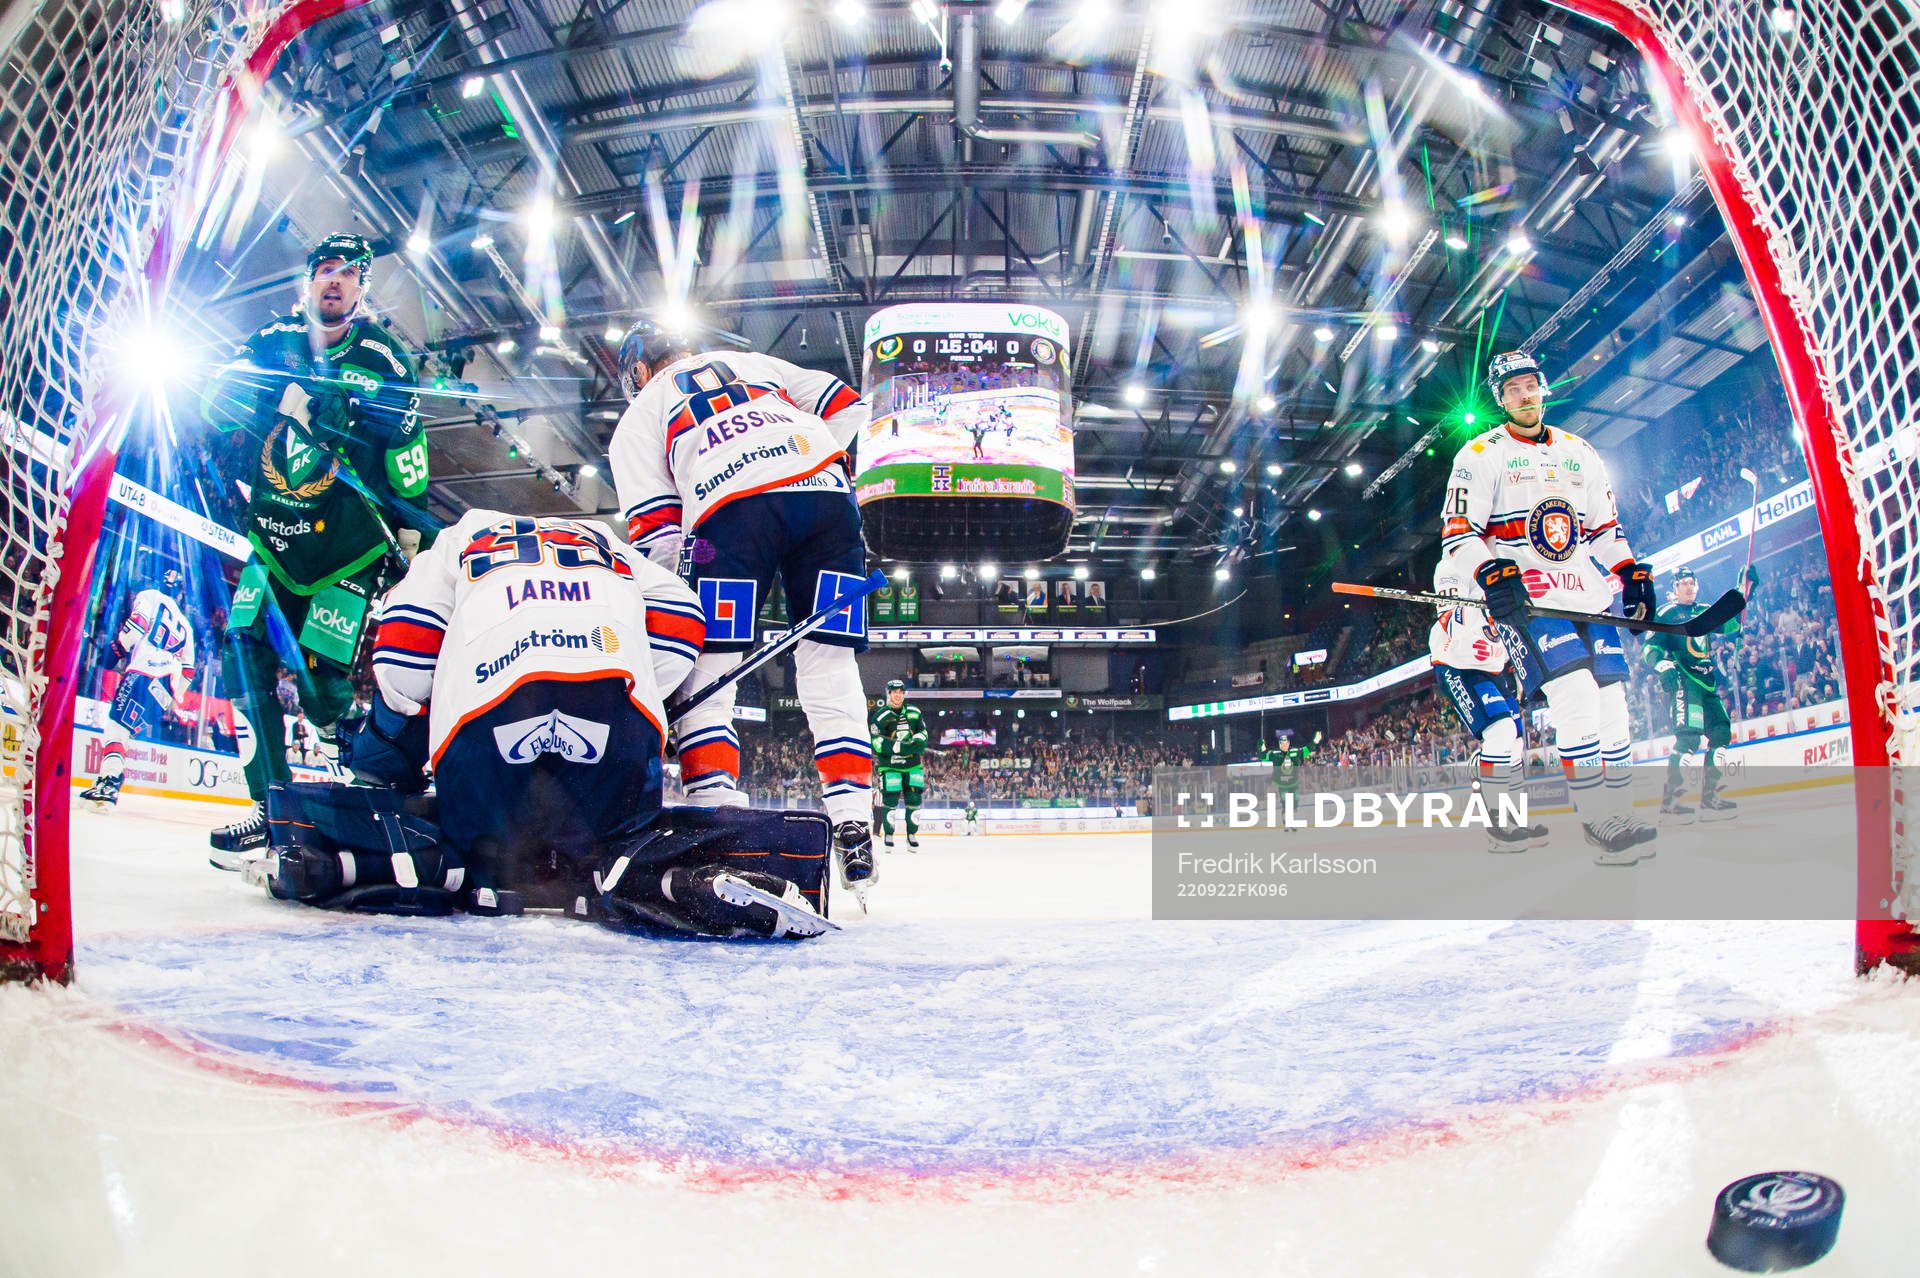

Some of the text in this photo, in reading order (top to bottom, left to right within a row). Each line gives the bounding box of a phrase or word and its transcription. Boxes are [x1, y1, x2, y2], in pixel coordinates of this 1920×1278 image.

[1008, 312, 1060, 336] voky
[913, 340, 926, 354] 0
[1006, 340, 1019, 354] 0
[342, 370, 379, 391] coop
[395, 445, 428, 488] 59
[695, 444, 788, 501] Sundström
[119, 482, 146, 507] UTAB
[1446, 488, 1468, 514] 26
[1757, 482, 1815, 525] Helmi
[208, 522, 236, 546] STENA
[1704, 525, 1737, 547] DAHL
[1486, 565, 1521, 586] CC
[1546, 572, 1585, 591] VIDA
[232, 585, 261, 604] oky
[340, 579, 366, 595] CCM
[506, 579, 592, 611] LARMI
[1373, 586, 1408, 595] CCM
[311, 603, 356, 635] voky
[475, 629, 588, 684] Sundström
[778, 698, 800, 707] THE
[1098, 698, 1132, 708] Wolfpack
[529, 734, 574, 756] Fleuss
[221, 769, 248, 785] CARL
